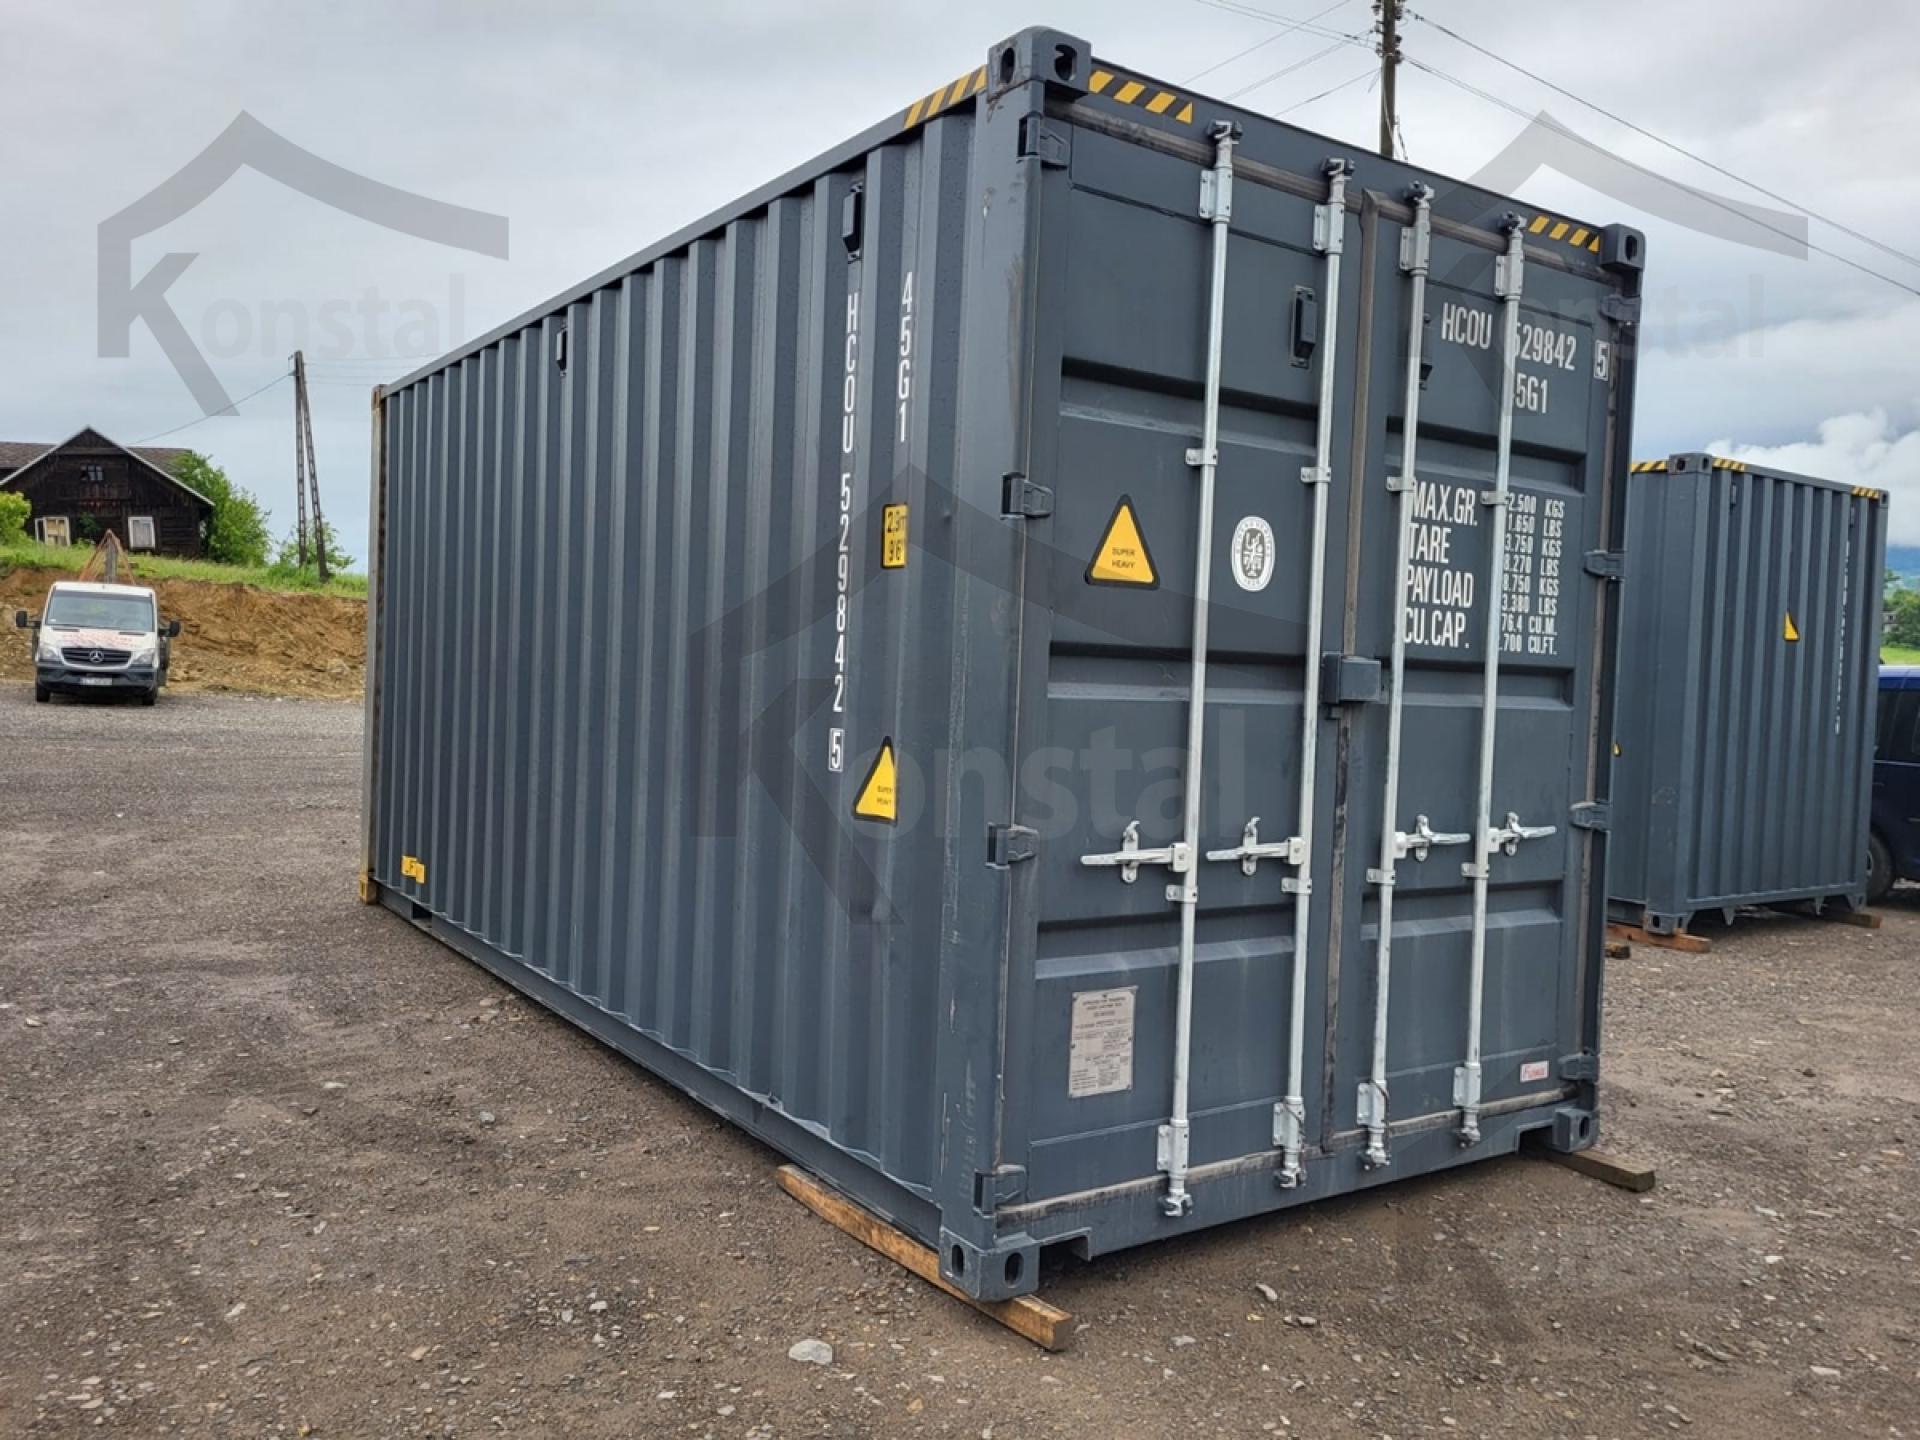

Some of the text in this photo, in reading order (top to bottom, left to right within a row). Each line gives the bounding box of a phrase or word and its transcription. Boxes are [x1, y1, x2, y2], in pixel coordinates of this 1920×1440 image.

[898, 271, 913, 442] 45G1
[1441, 302, 1492, 349] HCOU
[1595, 340, 1609, 380] 5
[1513, 372, 1549, 414] 5G1
[1412, 481, 1478, 526] MAX.GR.
[1544, 499, 1566, 518] KGS
[830, 292, 859, 770] HCOU 529842 5
[1408, 523, 1451, 563] TARE
[1541, 538, 1562, 558] KGS
[1111, 559, 1136, 569] HEAVY
[1112, 547, 1136, 557] SUPER
[1406, 565, 1474, 608] PAYLOAD
[1538, 577, 1560, 596] KGS
[1404, 608, 1470, 648] CU.CAP.
